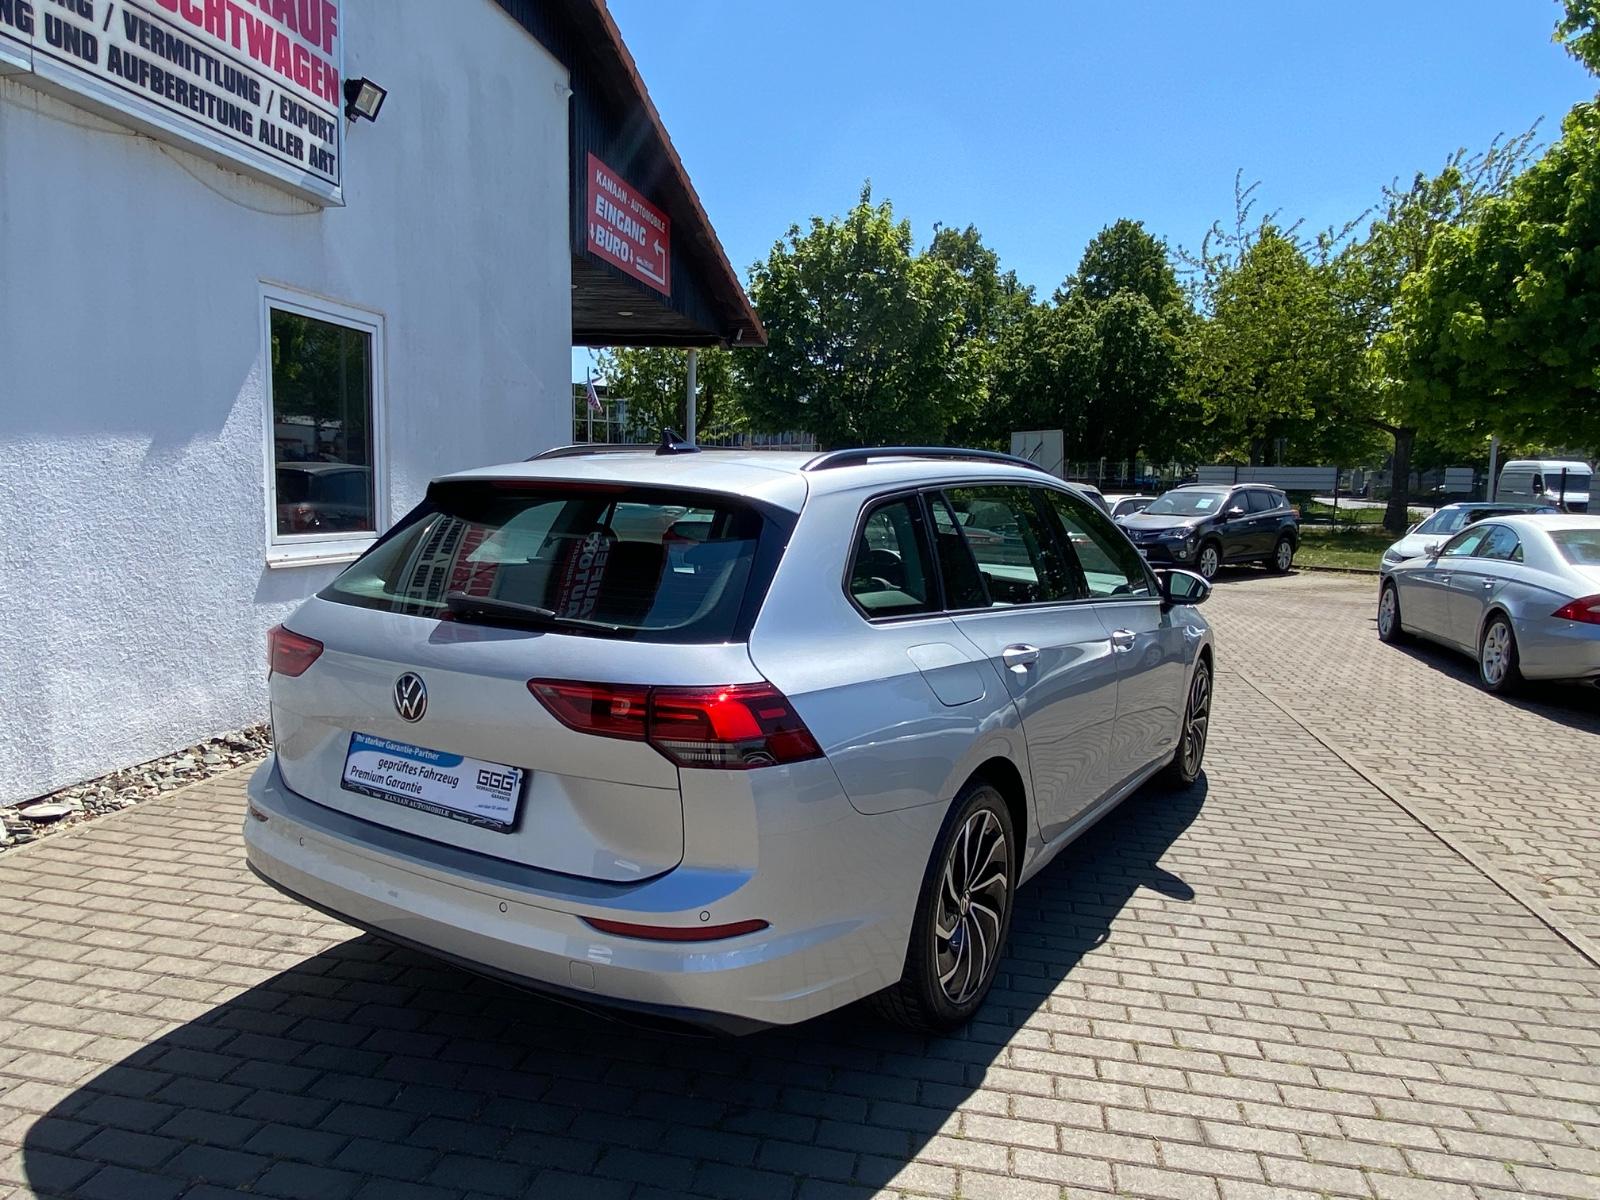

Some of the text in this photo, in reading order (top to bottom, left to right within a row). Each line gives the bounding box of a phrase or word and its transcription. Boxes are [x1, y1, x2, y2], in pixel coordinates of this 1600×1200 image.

[44, 12, 98, 65] UND
[107, 44, 254, 138] AUFBEREITUNG
[258, 119, 304, 161] ALLER
[308, 143, 336, 176] ART
[122, 9, 261, 107] VERMITTLUNG
[279, 94, 336, 145] EXPORT
[595, 193, 648, 247] EINGANG
[596, 169, 628, 205] KANAAN
[630, 198, 666, 234] AUTOMOBILE
[595, 224, 630, 263] BÜRO
[386, 741, 440, 761] Garantie-Partner
[350, 766, 423, 795] Premium Garantie
[377, 759, 460, 789] geprüftes Fahrzeug
[477, 769, 514, 792] GGG
